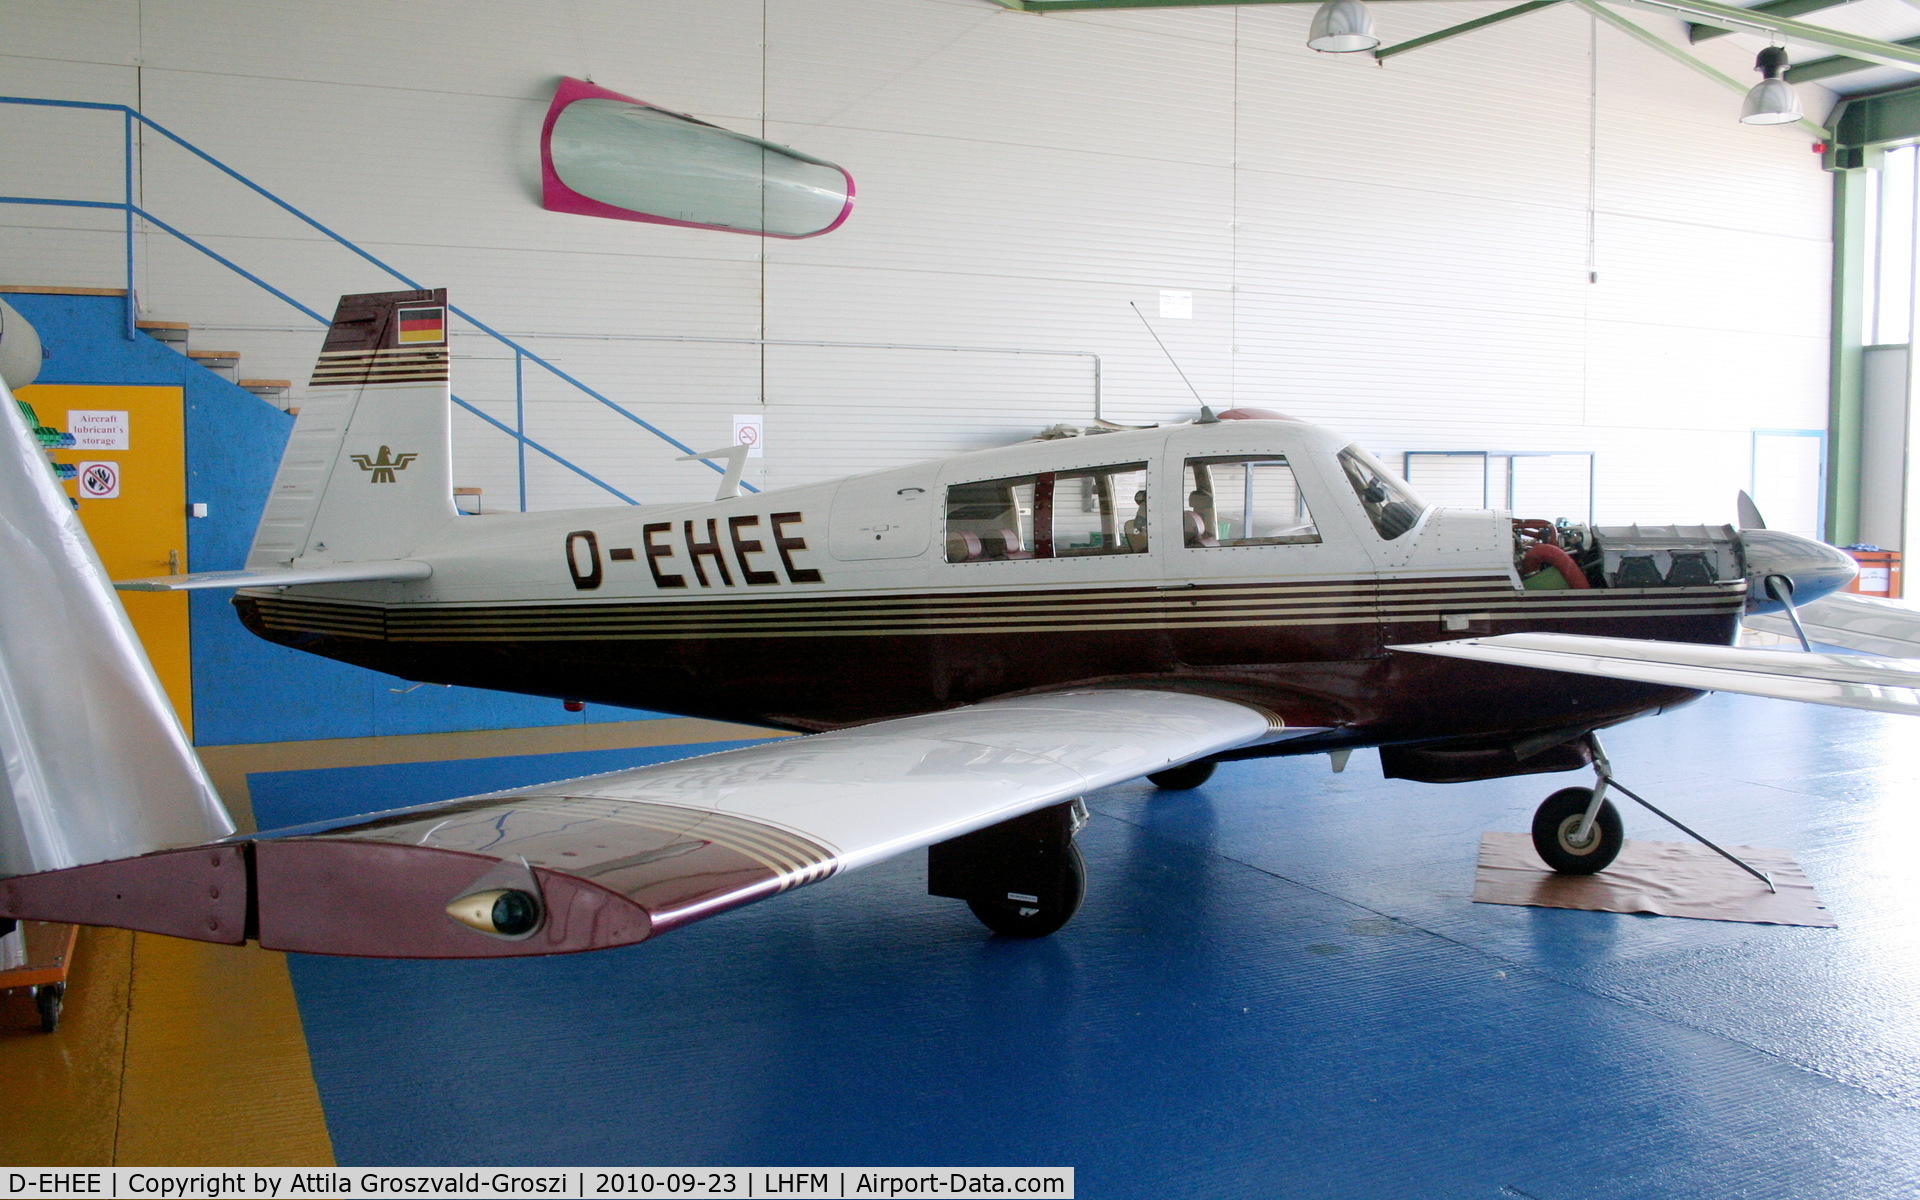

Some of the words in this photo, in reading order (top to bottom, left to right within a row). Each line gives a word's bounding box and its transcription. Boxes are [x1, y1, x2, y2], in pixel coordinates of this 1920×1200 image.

[80, 415, 117, 423] Aircraft
[82, 437, 116, 446] storage
[565, 511, 825, 591] D-EHEE
